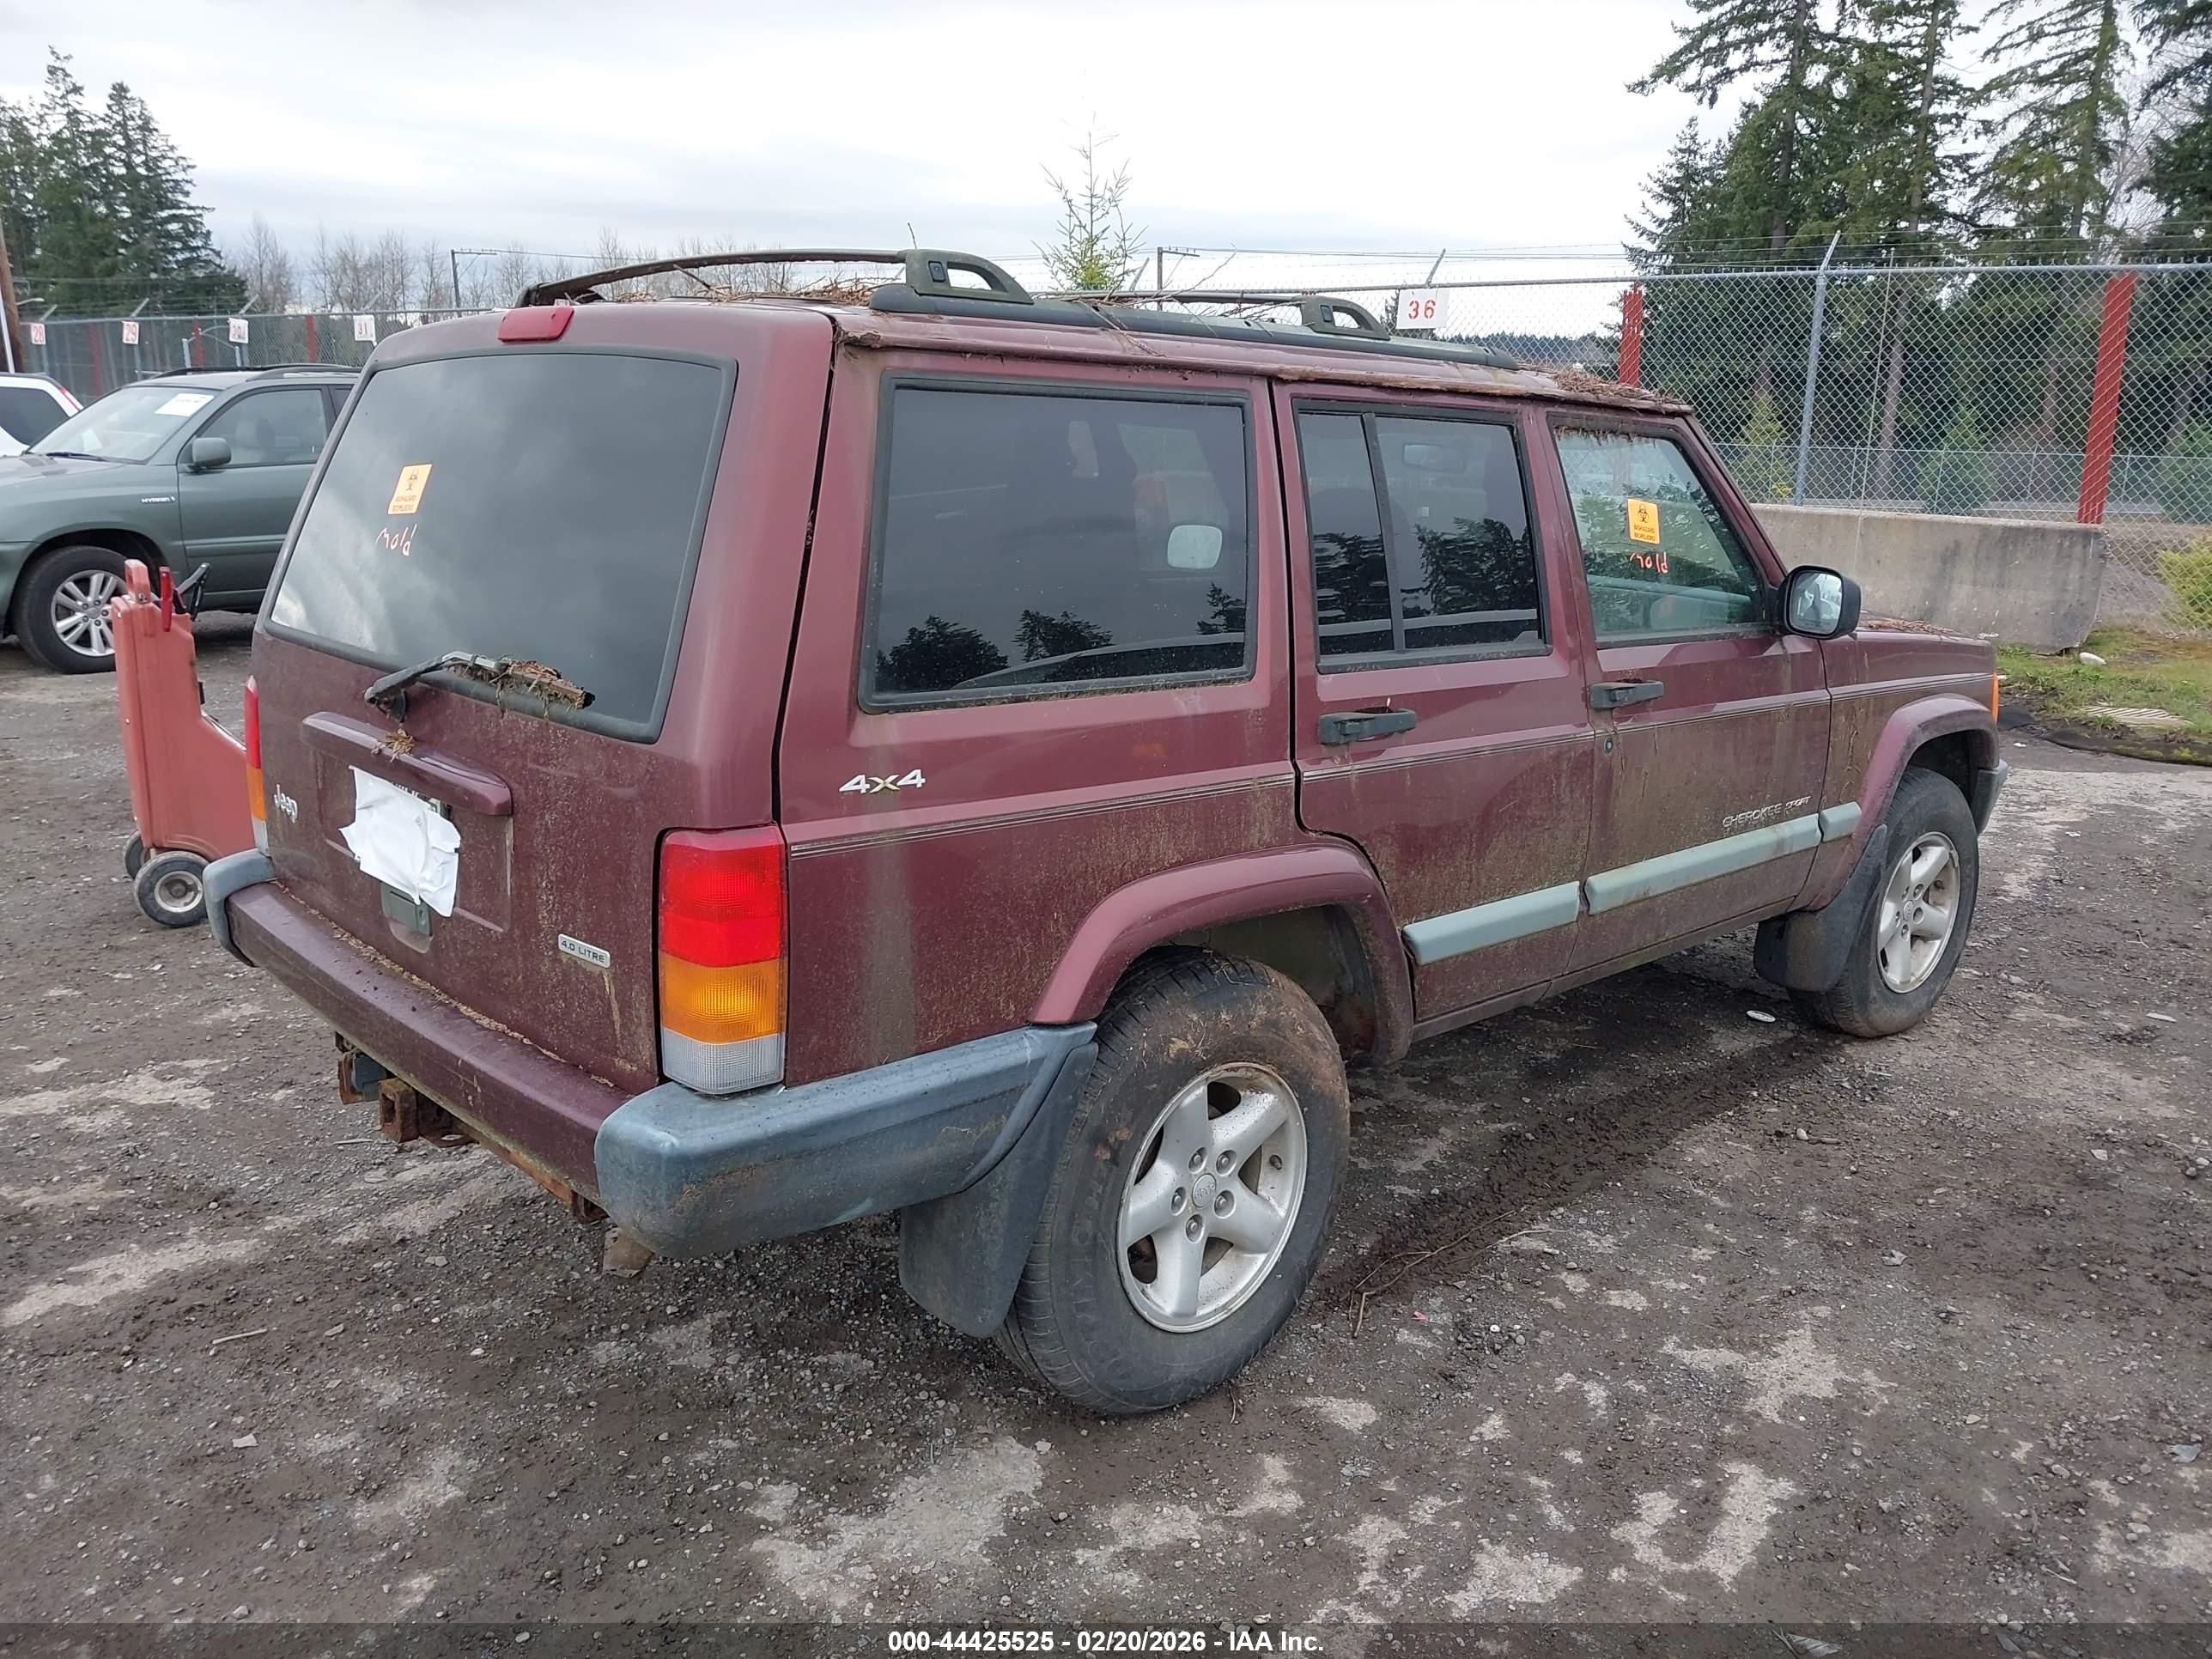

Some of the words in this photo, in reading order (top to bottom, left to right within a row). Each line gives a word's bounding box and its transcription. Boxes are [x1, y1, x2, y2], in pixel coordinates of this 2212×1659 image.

[1407, 299, 1437, 320] 36
[33, 325, 45, 343] 28
[126, 324, 137, 342] 29
[357, 322, 368, 337] 31
[273, 783, 299, 824] Jeep
[1723, 803, 1783, 828] CHEROKEE
[562, 940, 575, 951] 4.0
[578, 946, 605, 963] LITRE
